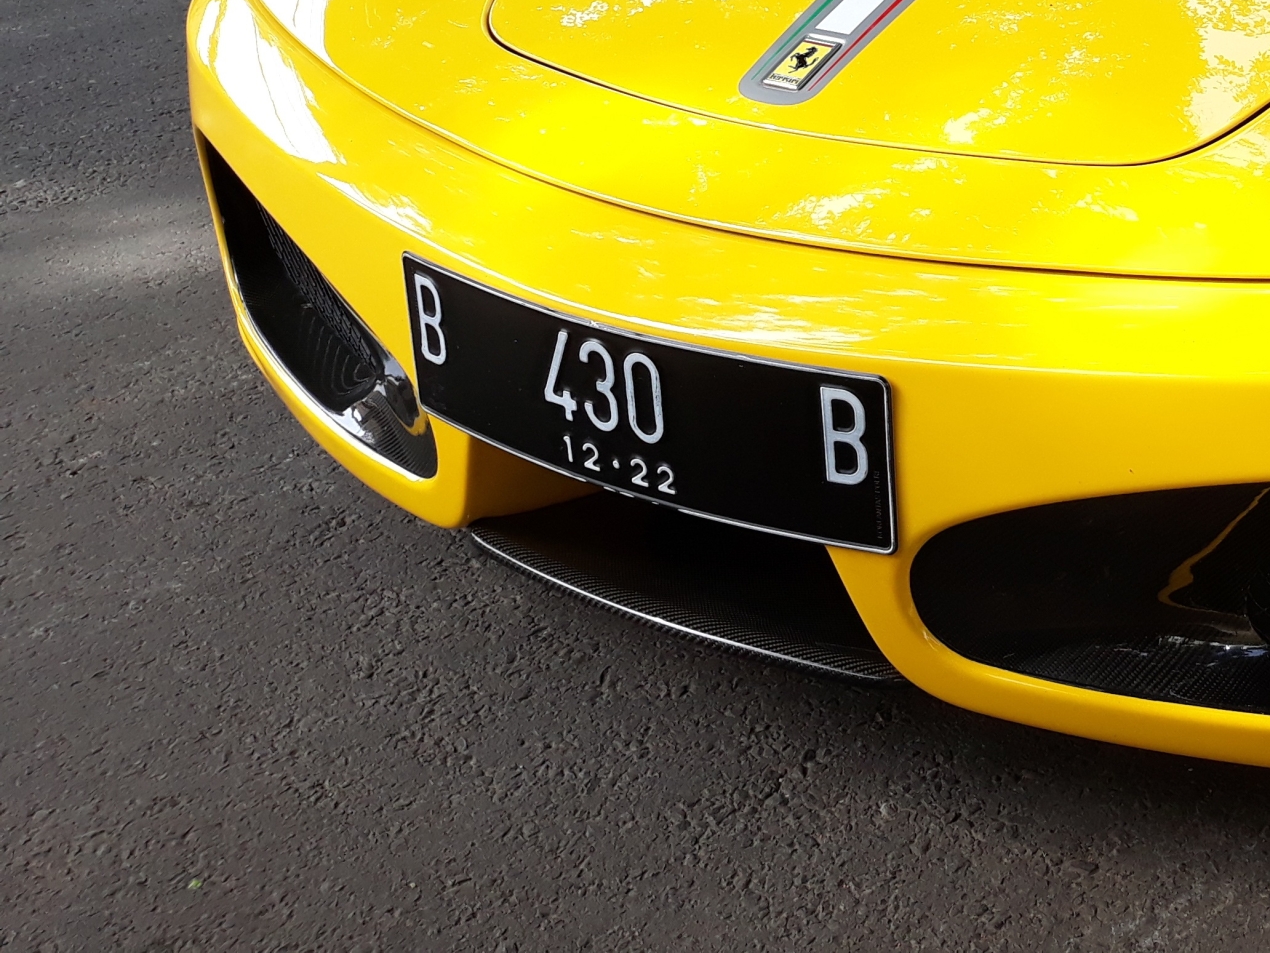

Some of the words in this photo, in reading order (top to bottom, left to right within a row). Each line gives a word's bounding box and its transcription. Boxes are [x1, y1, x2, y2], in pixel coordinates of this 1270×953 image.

[414, 273, 446, 365] B
[543, 329, 666, 445] 430
[820, 386, 867, 485] B
